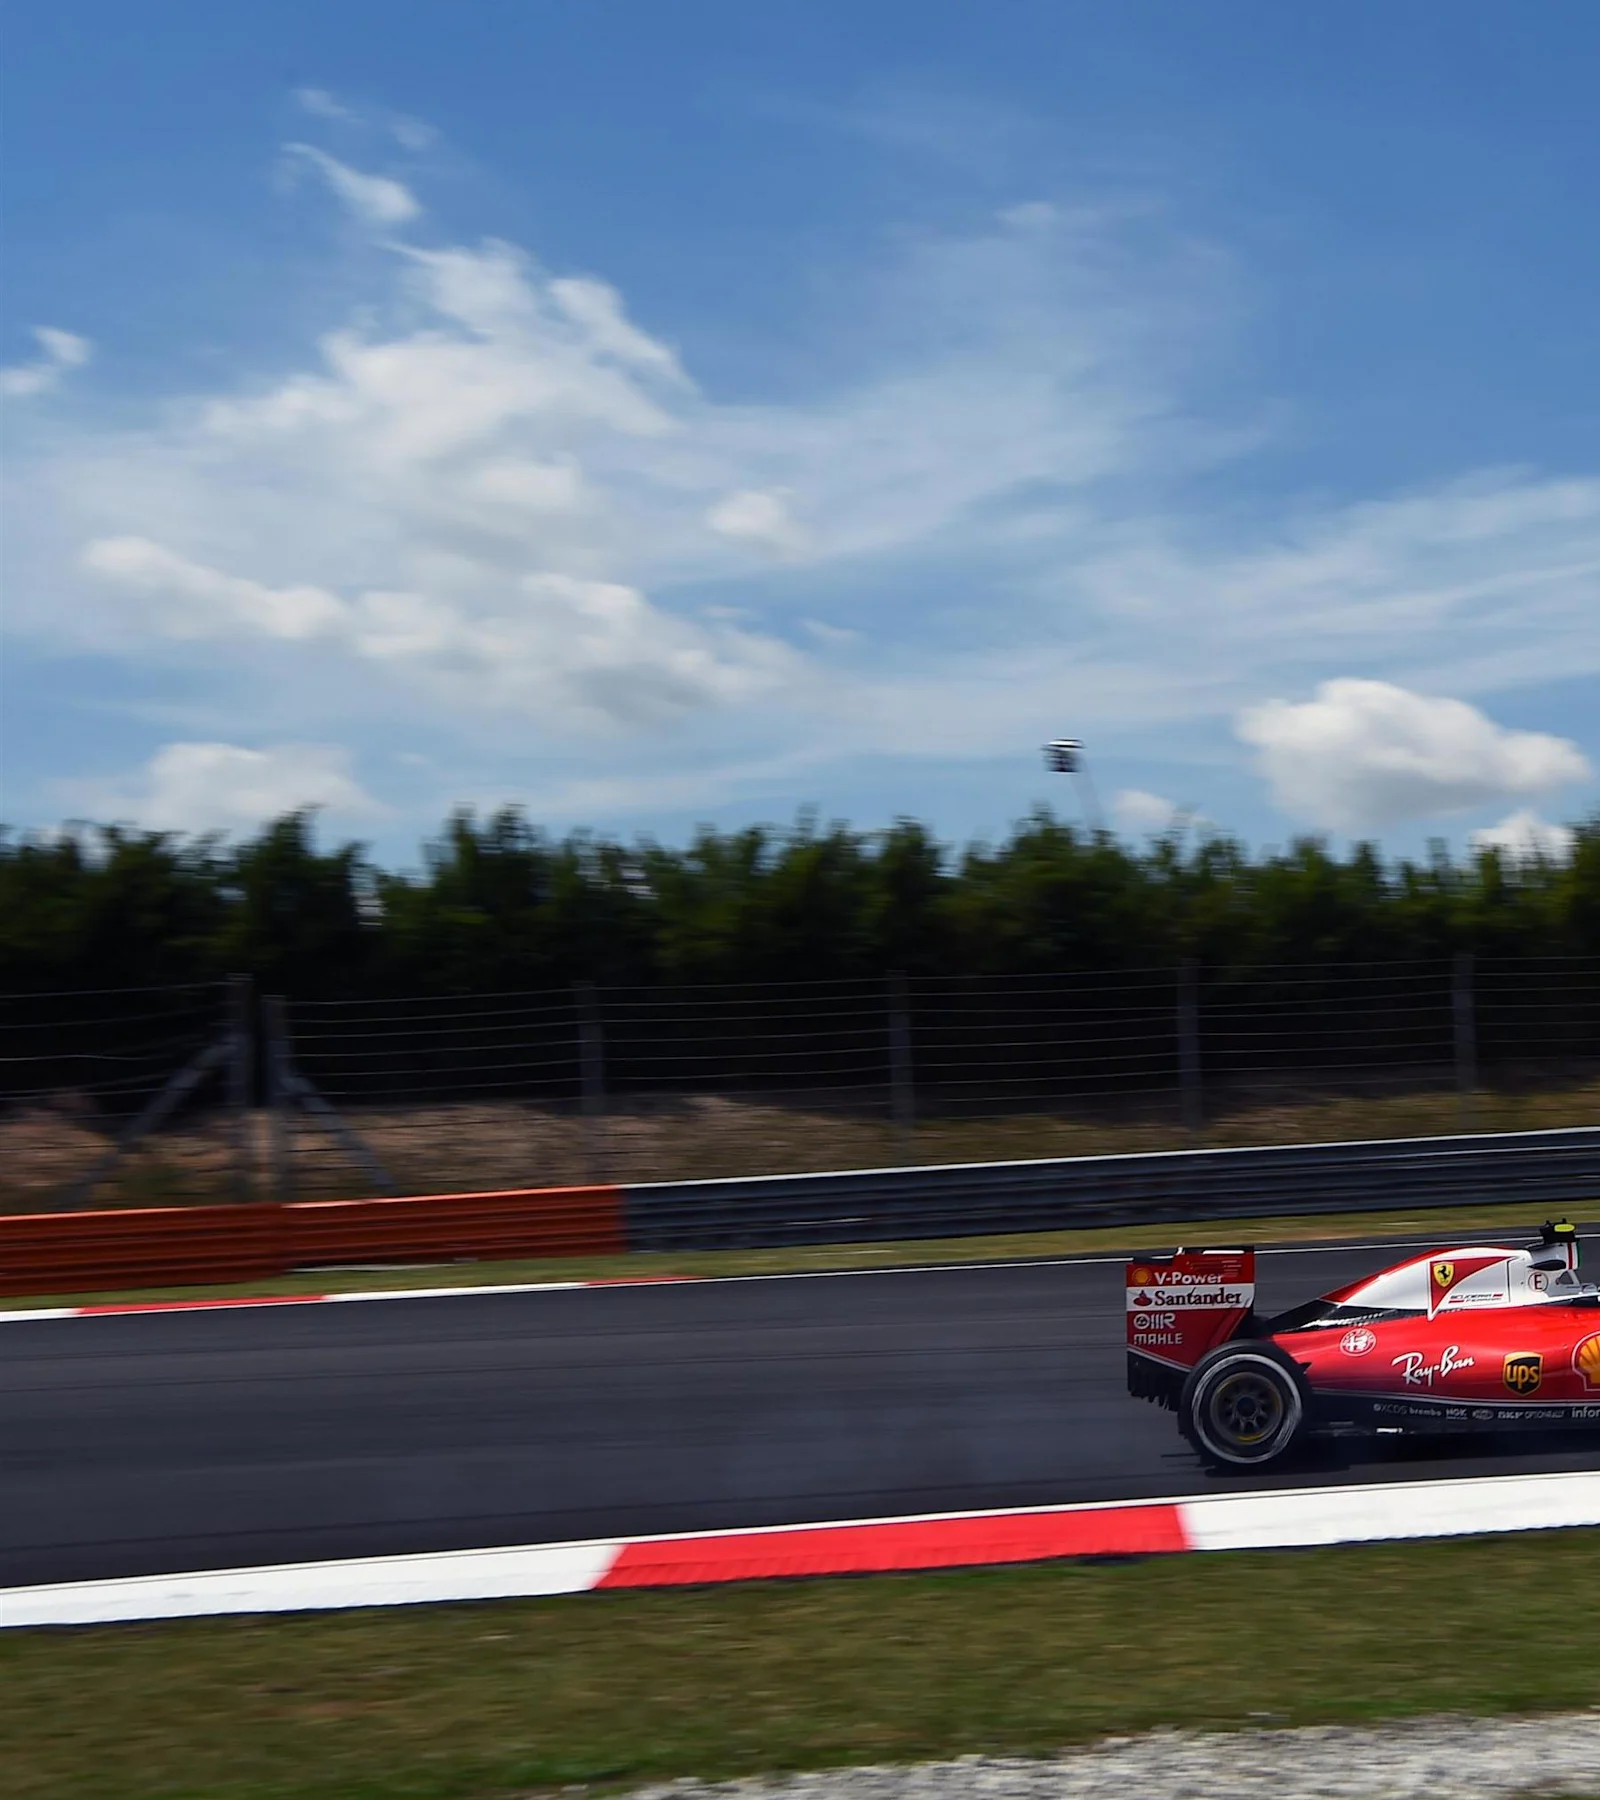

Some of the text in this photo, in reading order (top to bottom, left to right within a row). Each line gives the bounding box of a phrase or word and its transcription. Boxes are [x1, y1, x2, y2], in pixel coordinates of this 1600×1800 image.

[1154, 1271, 1223, 1285] V-Power
[1534, 1274, 1542, 1289] E
[1154, 1286, 1242, 1306] Santander
[1133, 1332, 1183, 1345] MAHLE
[1391, 1345, 1475, 1387] Ray-Ban
[1506, 1364, 1540, 1389] ups
